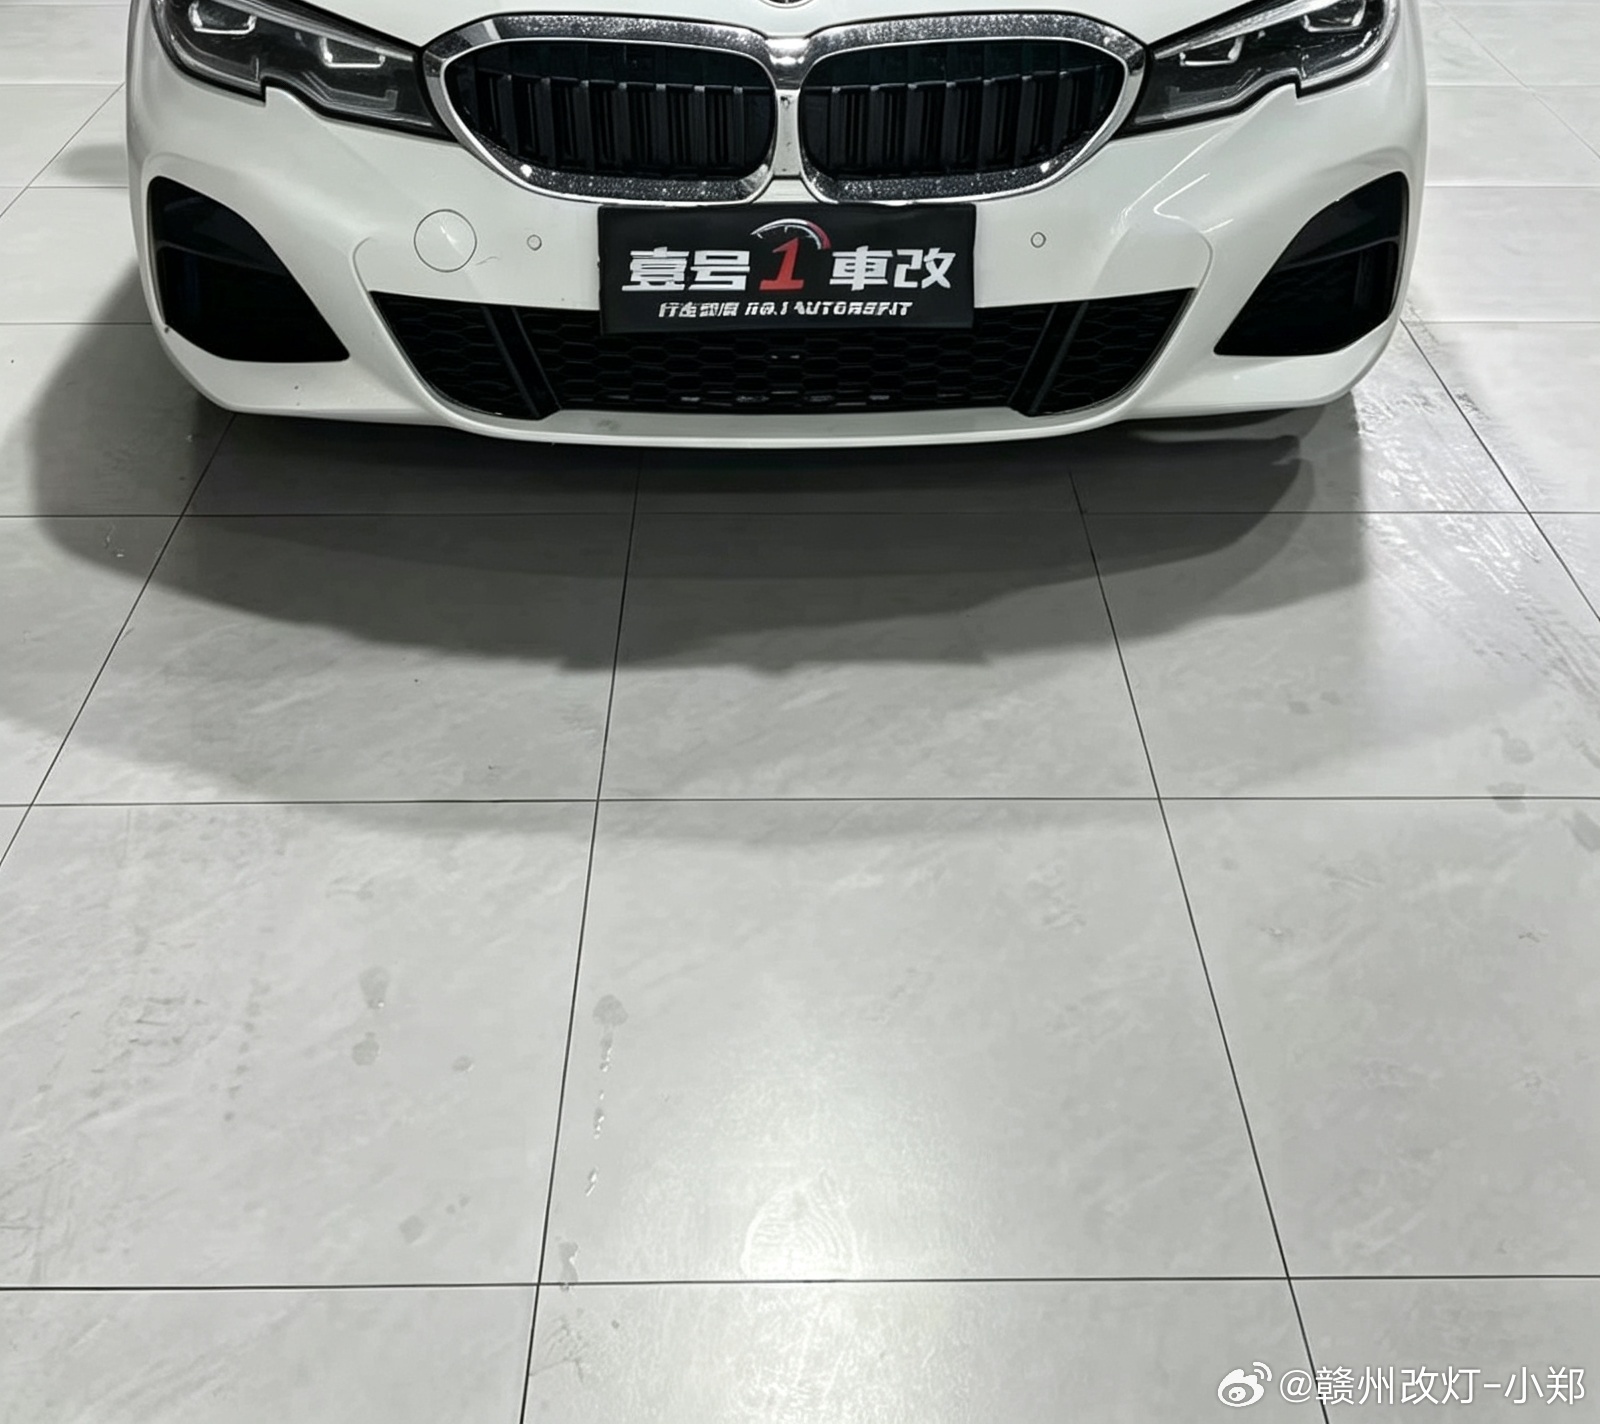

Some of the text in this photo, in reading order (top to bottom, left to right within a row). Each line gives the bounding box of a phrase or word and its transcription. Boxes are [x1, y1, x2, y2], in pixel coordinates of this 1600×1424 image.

[622, 237, 956, 291] 壹号 1 車改
